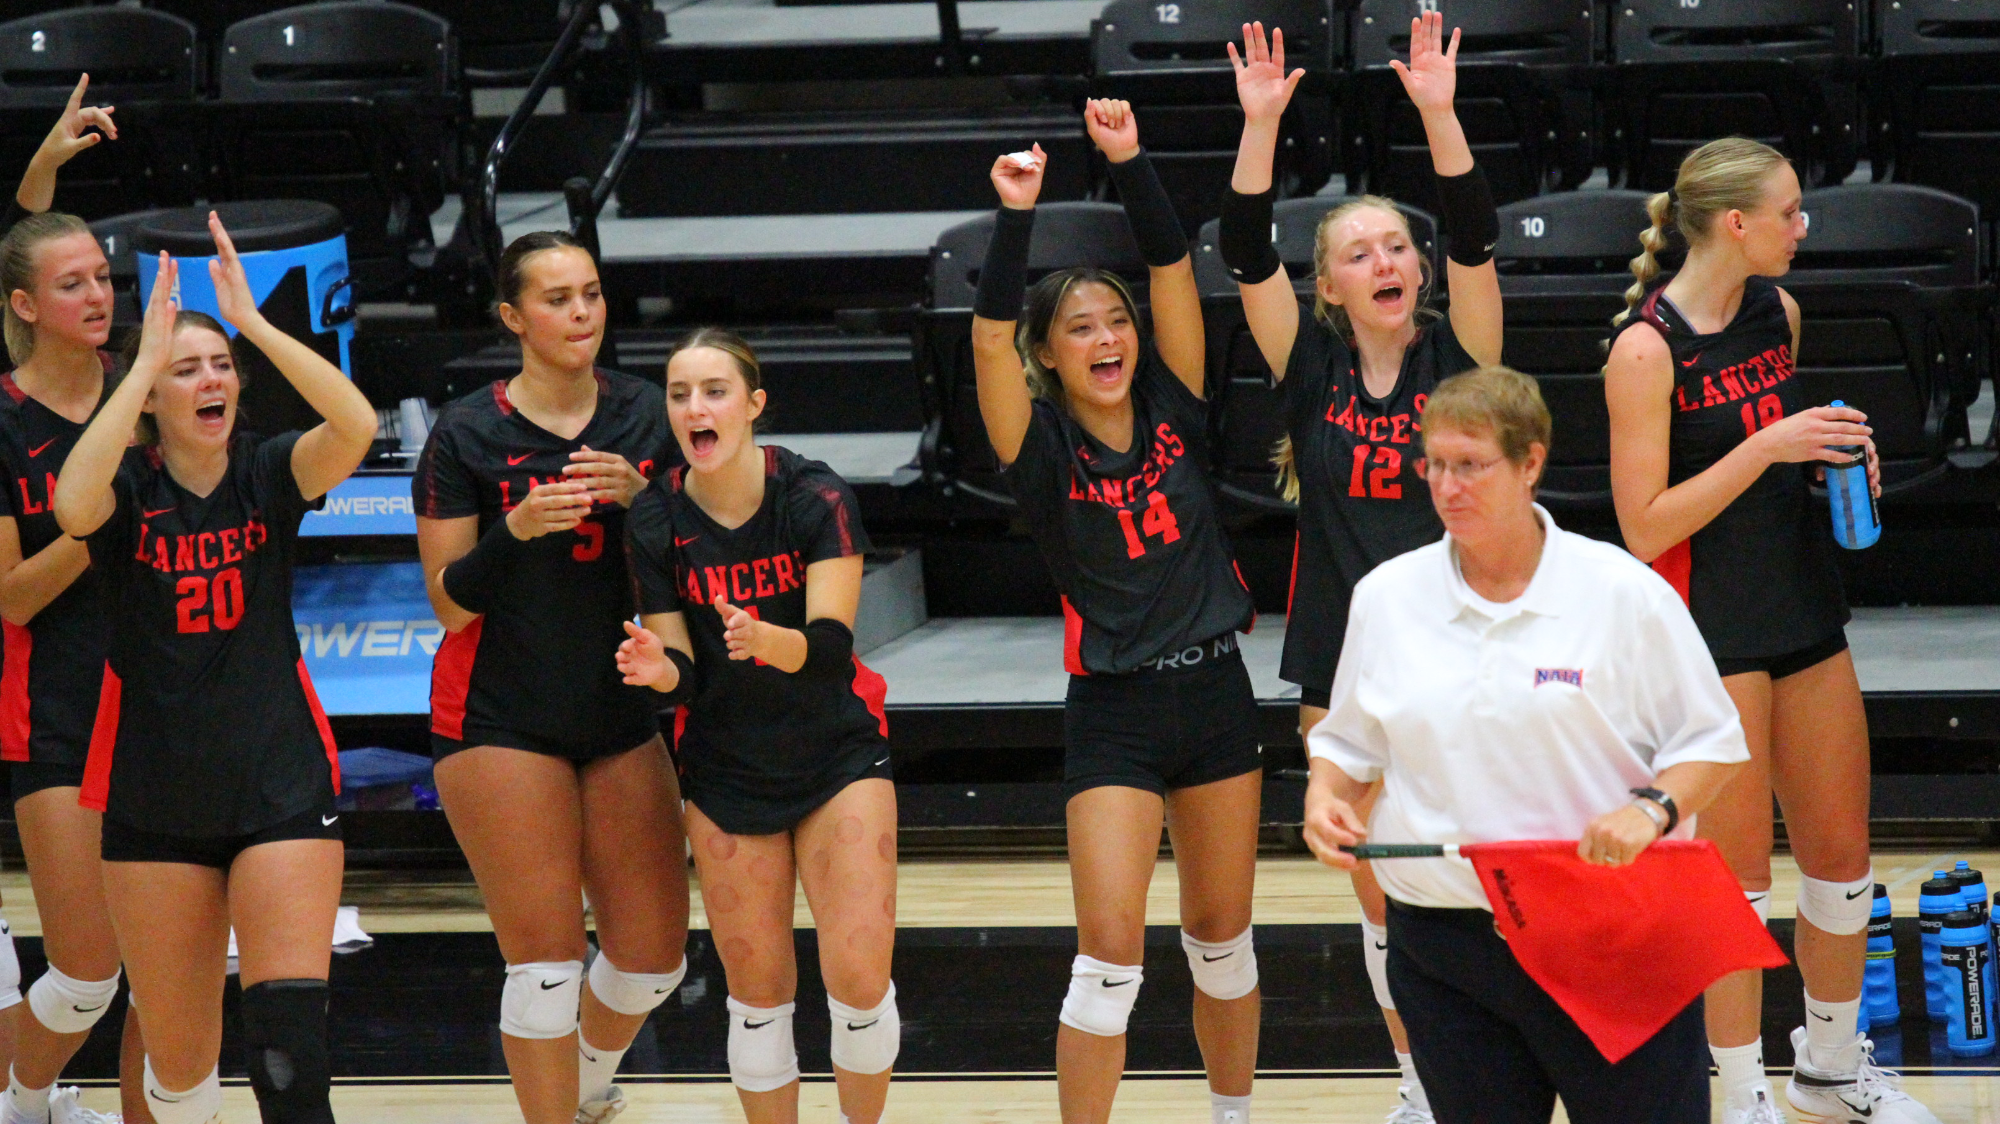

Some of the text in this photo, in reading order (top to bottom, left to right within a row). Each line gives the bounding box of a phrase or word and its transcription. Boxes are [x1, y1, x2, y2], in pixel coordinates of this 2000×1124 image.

[1156, 3, 1180, 24] 12
[31, 31, 46, 52] 2
[283, 25, 295, 46] 1
[1520, 217, 1545, 238] 10
[105, 236, 115, 255] 1
[1349, 444, 1402, 499] 12
[1117, 490, 1181, 560] 14
[175, 567, 245, 634] 20
[1535, 669, 1582, 687] NAIA
[1965, 946, 1983, 1036] POWERADE
